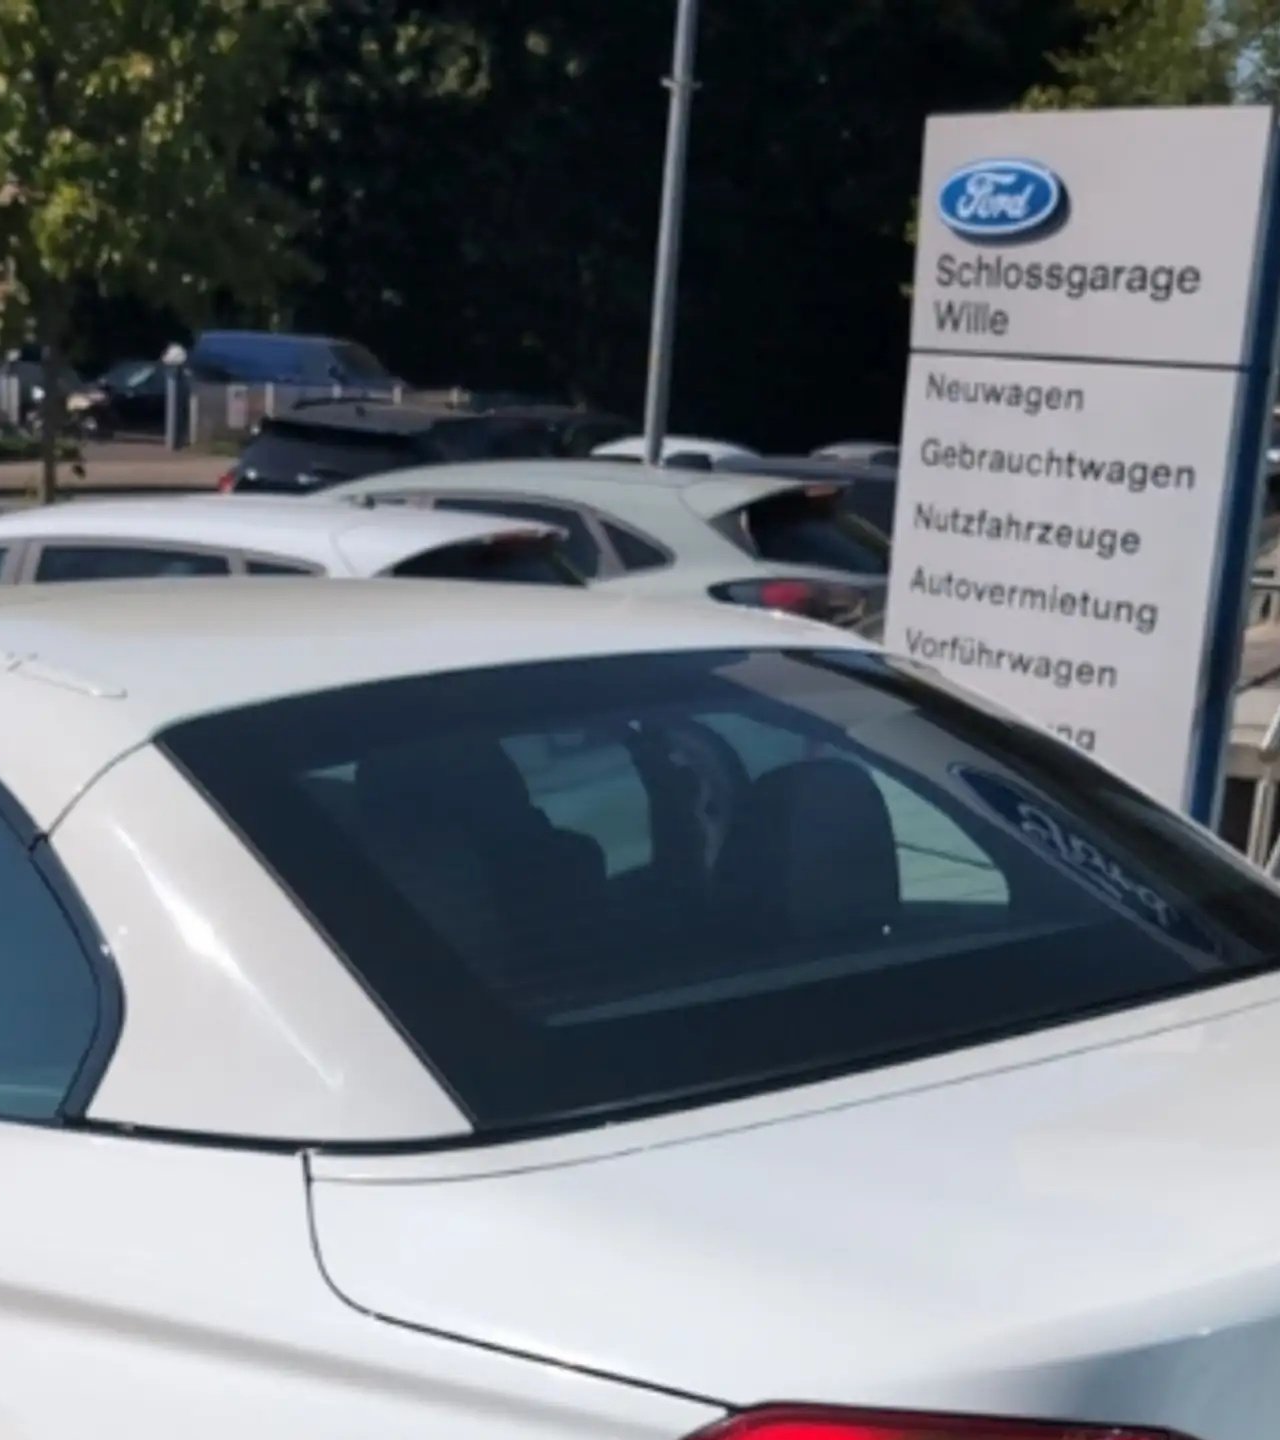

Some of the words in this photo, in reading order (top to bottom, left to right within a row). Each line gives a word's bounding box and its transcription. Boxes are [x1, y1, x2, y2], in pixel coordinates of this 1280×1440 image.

[957, 171, 1033, 220] Ford
[934, 253, 1202, 301] Schlossgarage
[933, 300, 1010, 337] Wille
[925, 372, 1085, 416] Neuwagen
[920, 437, 1197, 493] Gebrauchtwagen
[913, 502, 1142, 559] Nutzfahrzeuge
[908, 566, 1159, 634] Autovermietung
[905, 628, 1118, 689] Vorführwagen
